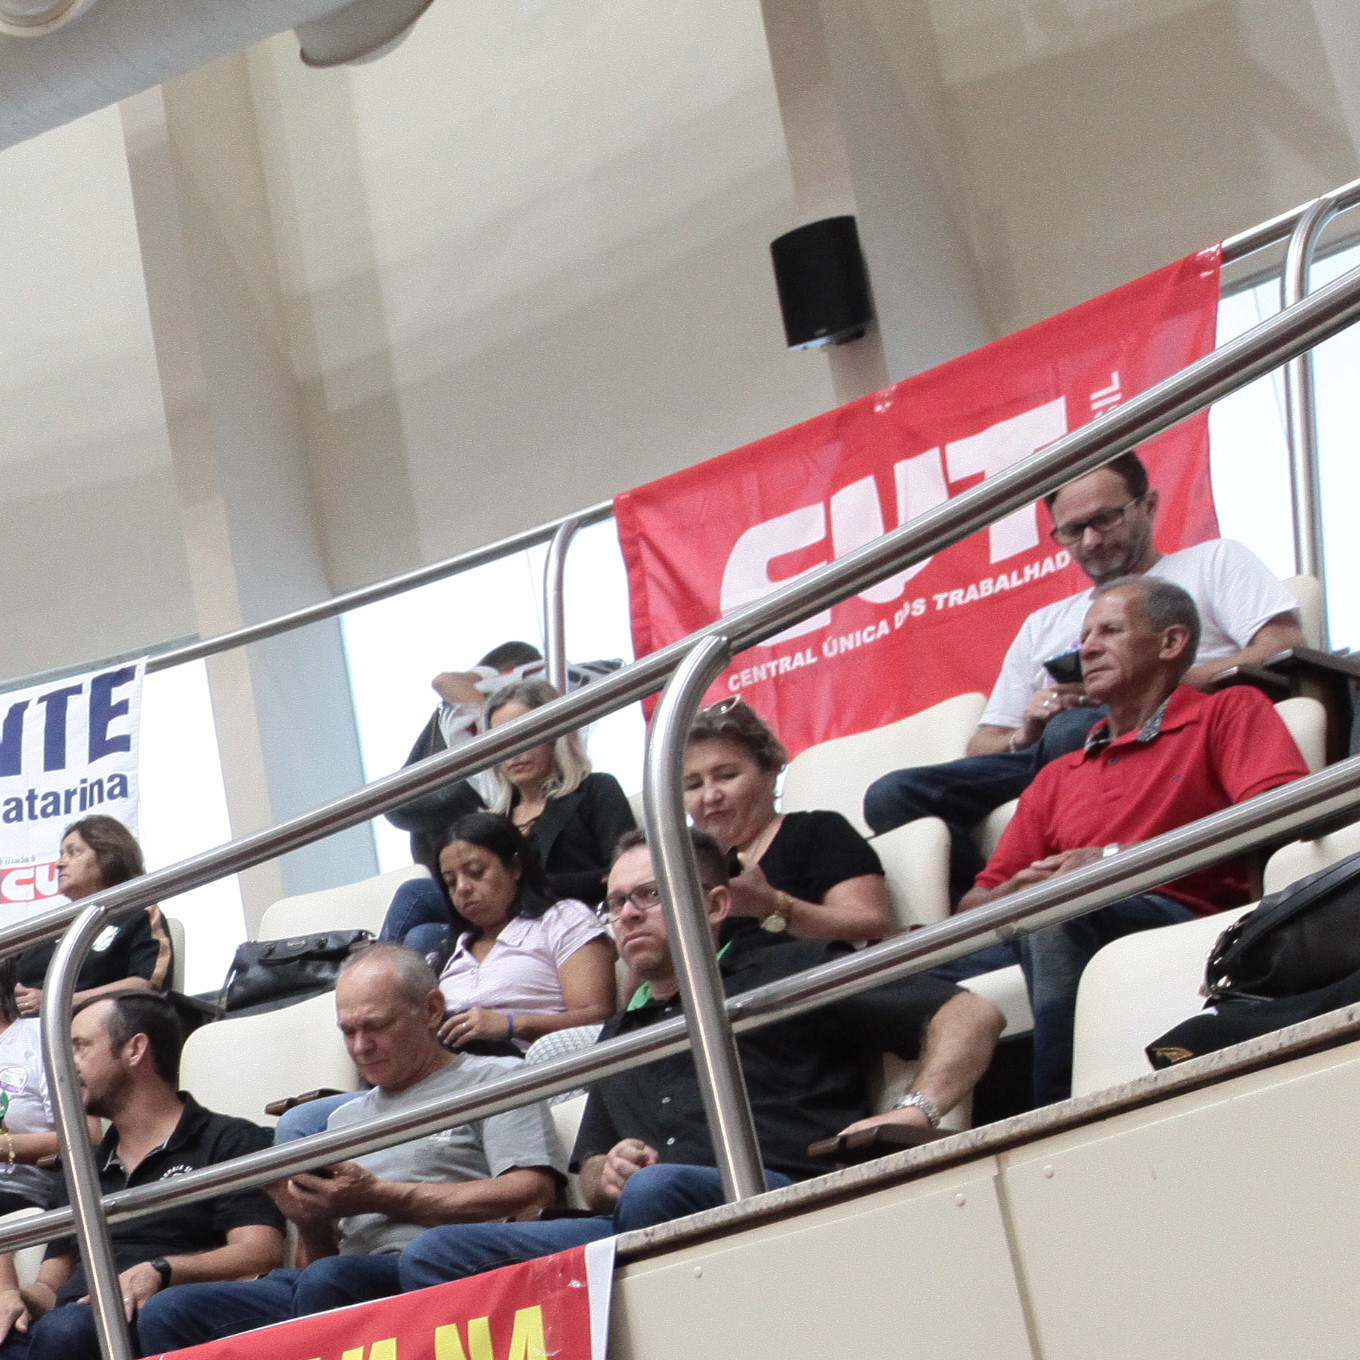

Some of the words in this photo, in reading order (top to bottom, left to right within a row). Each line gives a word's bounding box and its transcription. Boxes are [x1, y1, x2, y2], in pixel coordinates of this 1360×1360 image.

[728, 649, 817, 692] CENTRAL
[823, 617, 891, 658] ÚNICA
[933, 550, 1072, 612] TRABALHAD
[1, 863, 59, 901] CU
